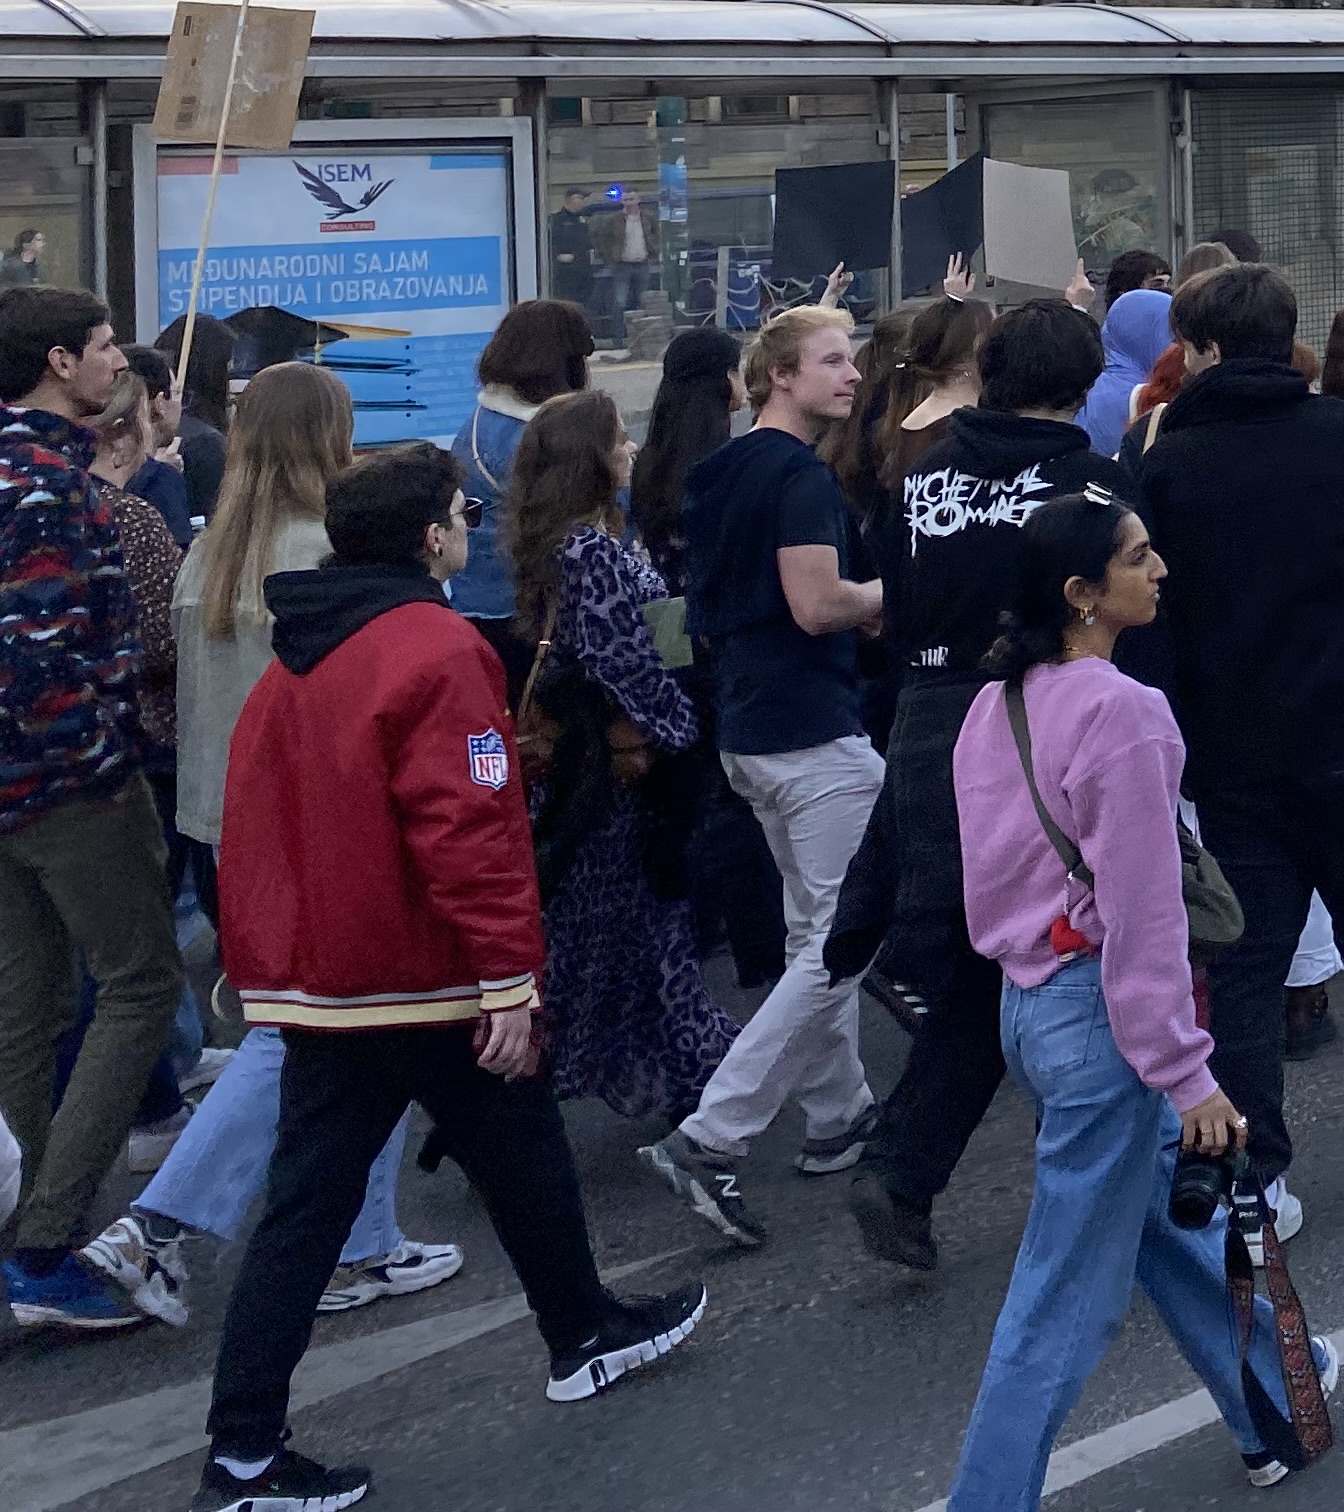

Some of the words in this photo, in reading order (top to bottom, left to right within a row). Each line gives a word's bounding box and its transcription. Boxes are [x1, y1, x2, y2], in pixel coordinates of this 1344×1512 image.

[353, 251, 430, 276] SAJAM
[316, 284, 322, 304] I
[331, 274, 489, 302] OBRAZOVANJA
[476, 756, 507, 782] NFL
